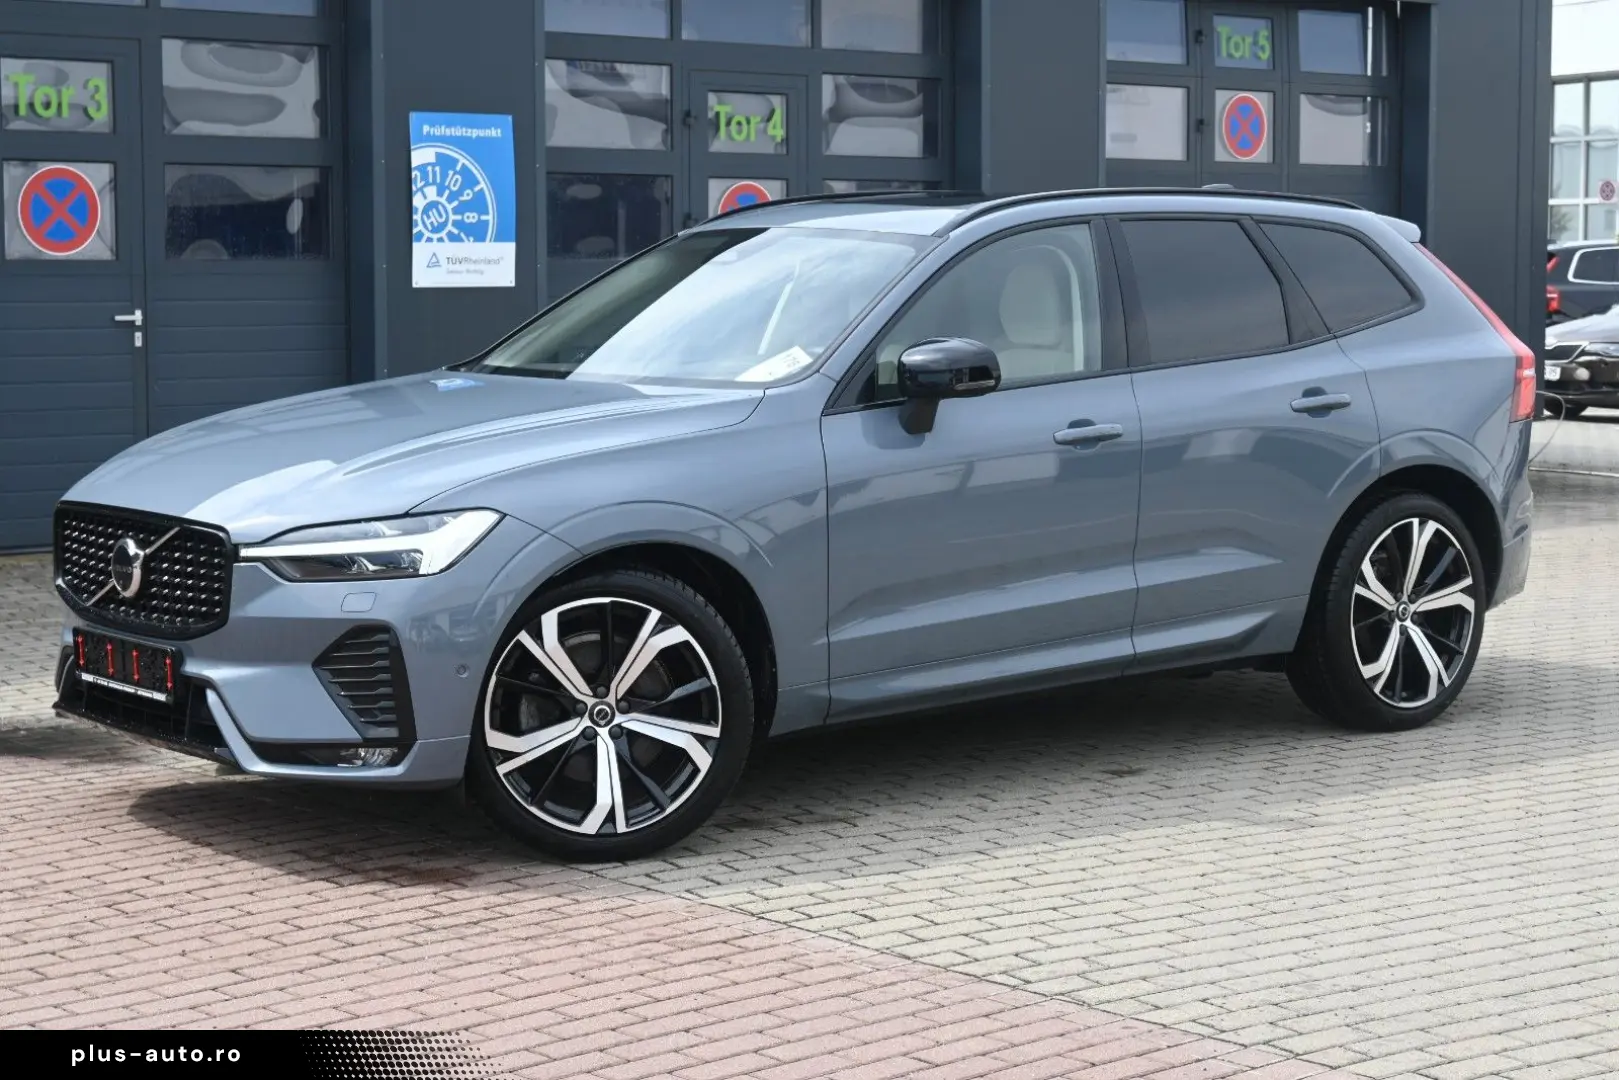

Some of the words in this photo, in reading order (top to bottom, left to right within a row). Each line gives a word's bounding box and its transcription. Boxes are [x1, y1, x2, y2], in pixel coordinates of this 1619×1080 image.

[1216, 26, 1252, 59] Tor
[1257, 28, 1271, 60] 5
[7, 73, 75, 118] Tor
[85, 78, 108, 119] 3
[423, 125, 502, 139] Prüfstützpunkt
[713, 104, 761, 141] Tor
[767, 107, 784, 143] 4
[427, 165, 440, 183] 11
[445, 170, 462, 191] 10
[423, 203, 447, 231] HU
[463, 212, 479, 223] 8
